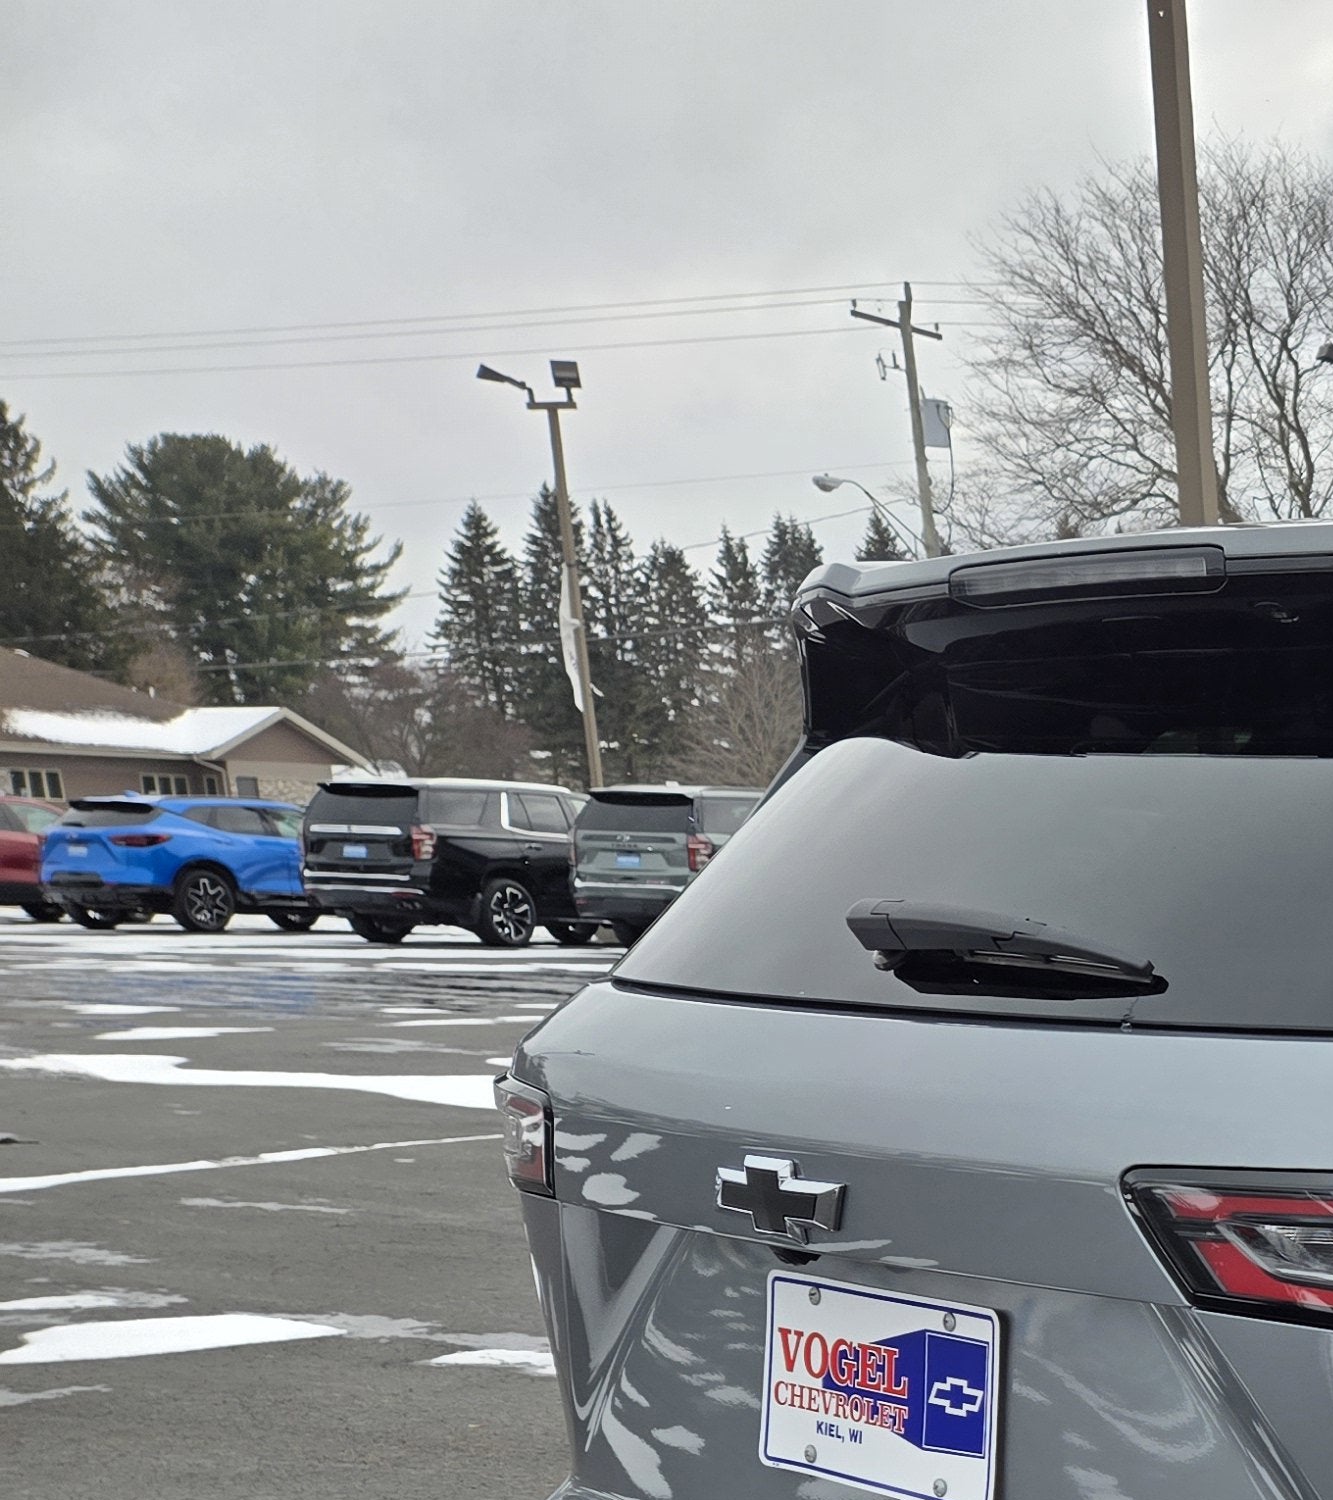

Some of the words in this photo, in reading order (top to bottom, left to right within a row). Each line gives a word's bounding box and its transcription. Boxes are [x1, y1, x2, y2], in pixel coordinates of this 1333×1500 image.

[777, 1327, 908, 1398] VOGEL
[774, 1380, 909, 1434] CHEVROLET
[816, 1420, 845, 1443] KIEL,
[848, 1428, 863, 1444] WI
